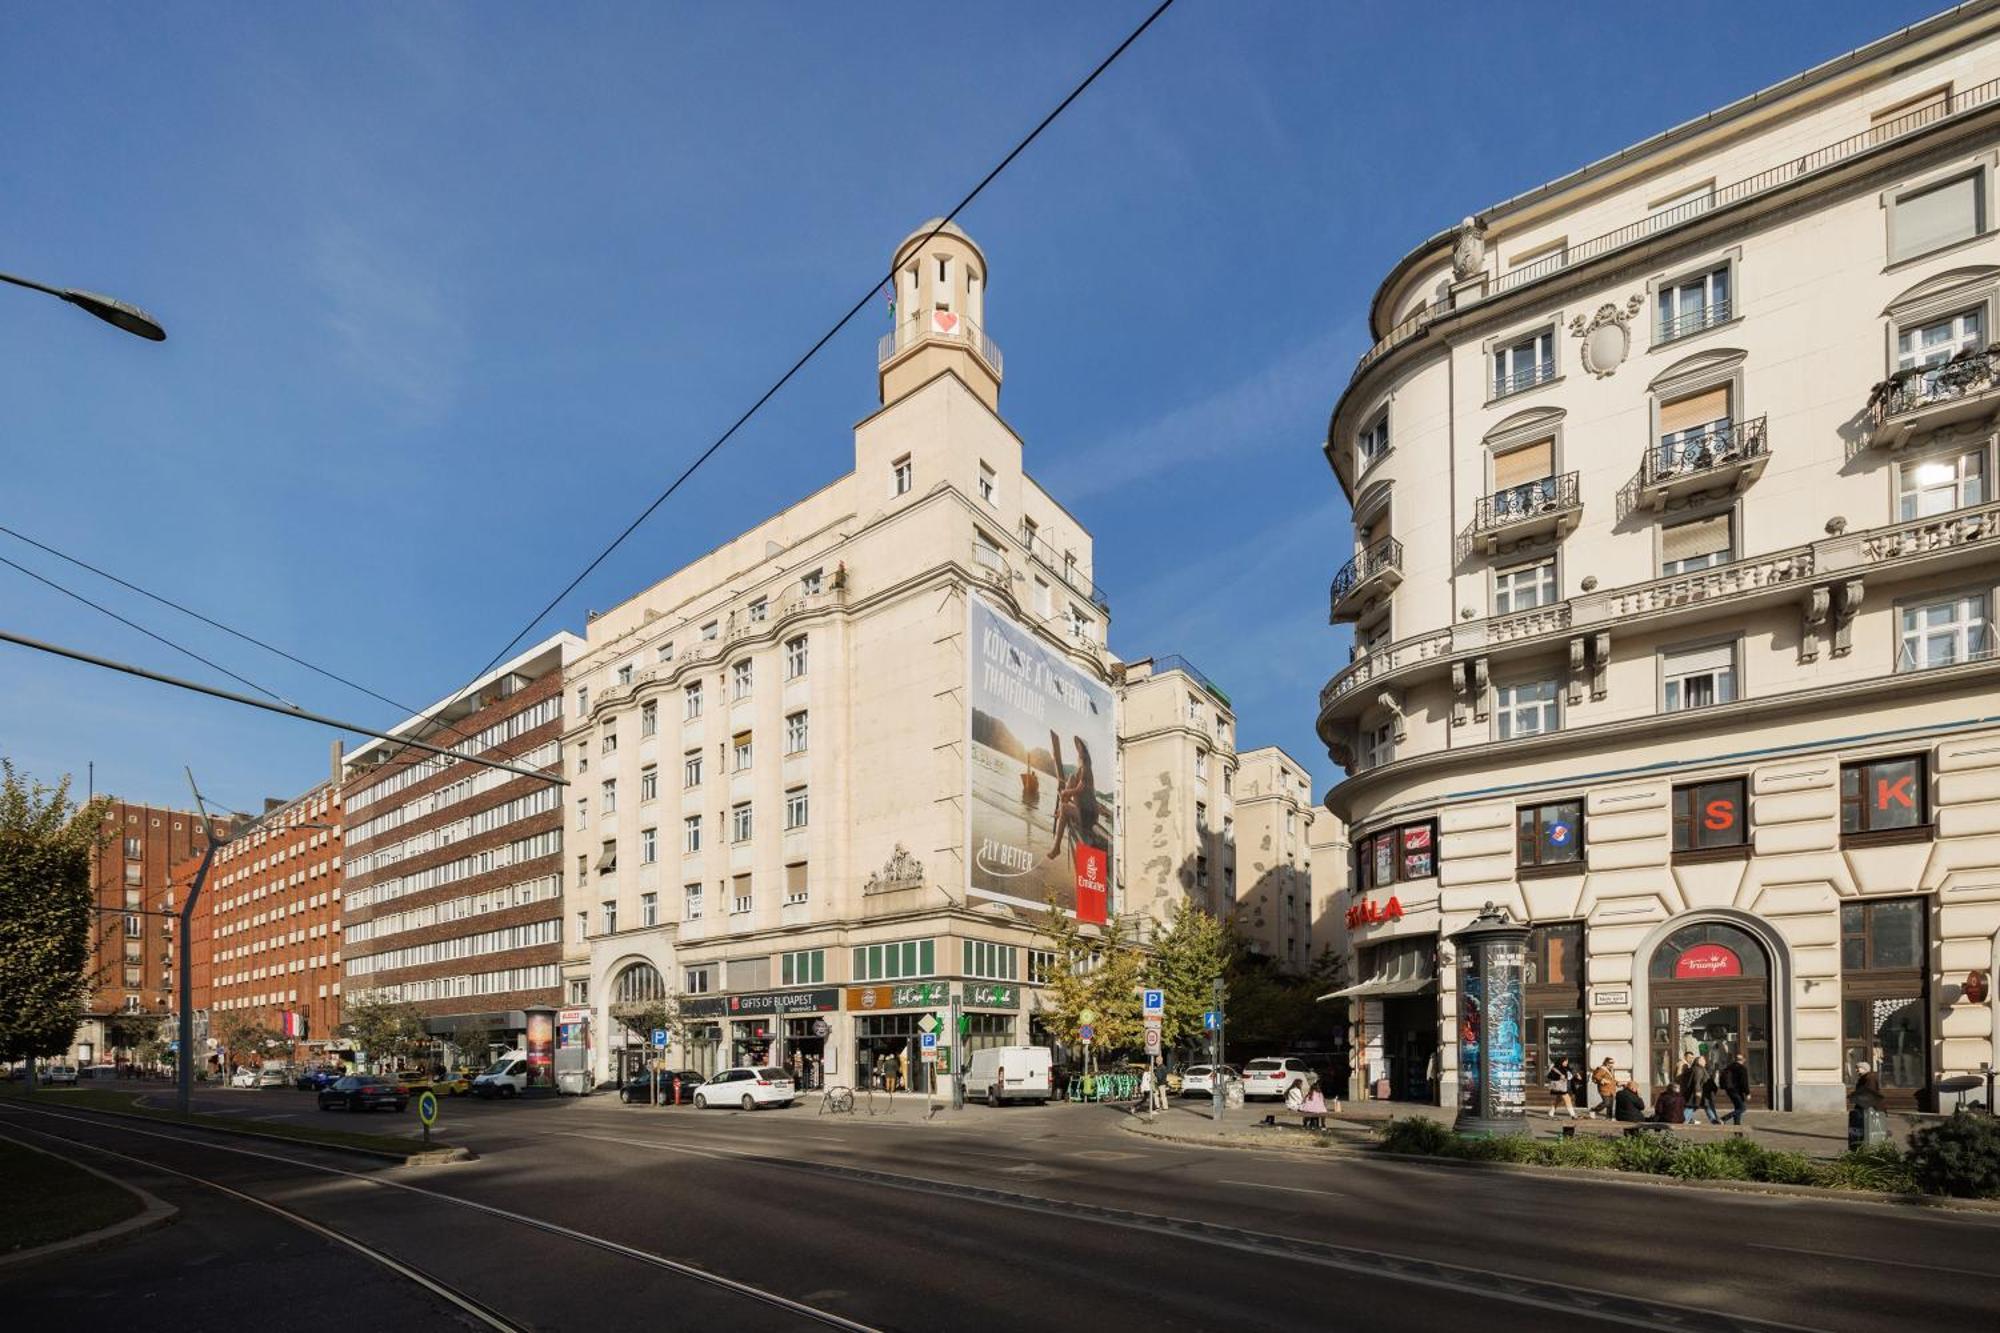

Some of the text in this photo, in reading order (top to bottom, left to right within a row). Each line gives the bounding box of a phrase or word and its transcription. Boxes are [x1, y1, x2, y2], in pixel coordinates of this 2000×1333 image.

[1876, 775, 1913, 811] K
[1704, 800, 1735, 830] S
[982, 838, 1033, 873] FLY BETTER
[1078, 875, 1105, 893] Emirates
[1681, 956, 1728, 972] Triumph
[741, 994, 813, 1009] GIFTS OF BUDAPEST
[1148, 993, 1158, 1007] P
[656, 1030, 665, 1045] P
[924, 1035, 933, 1047] P
